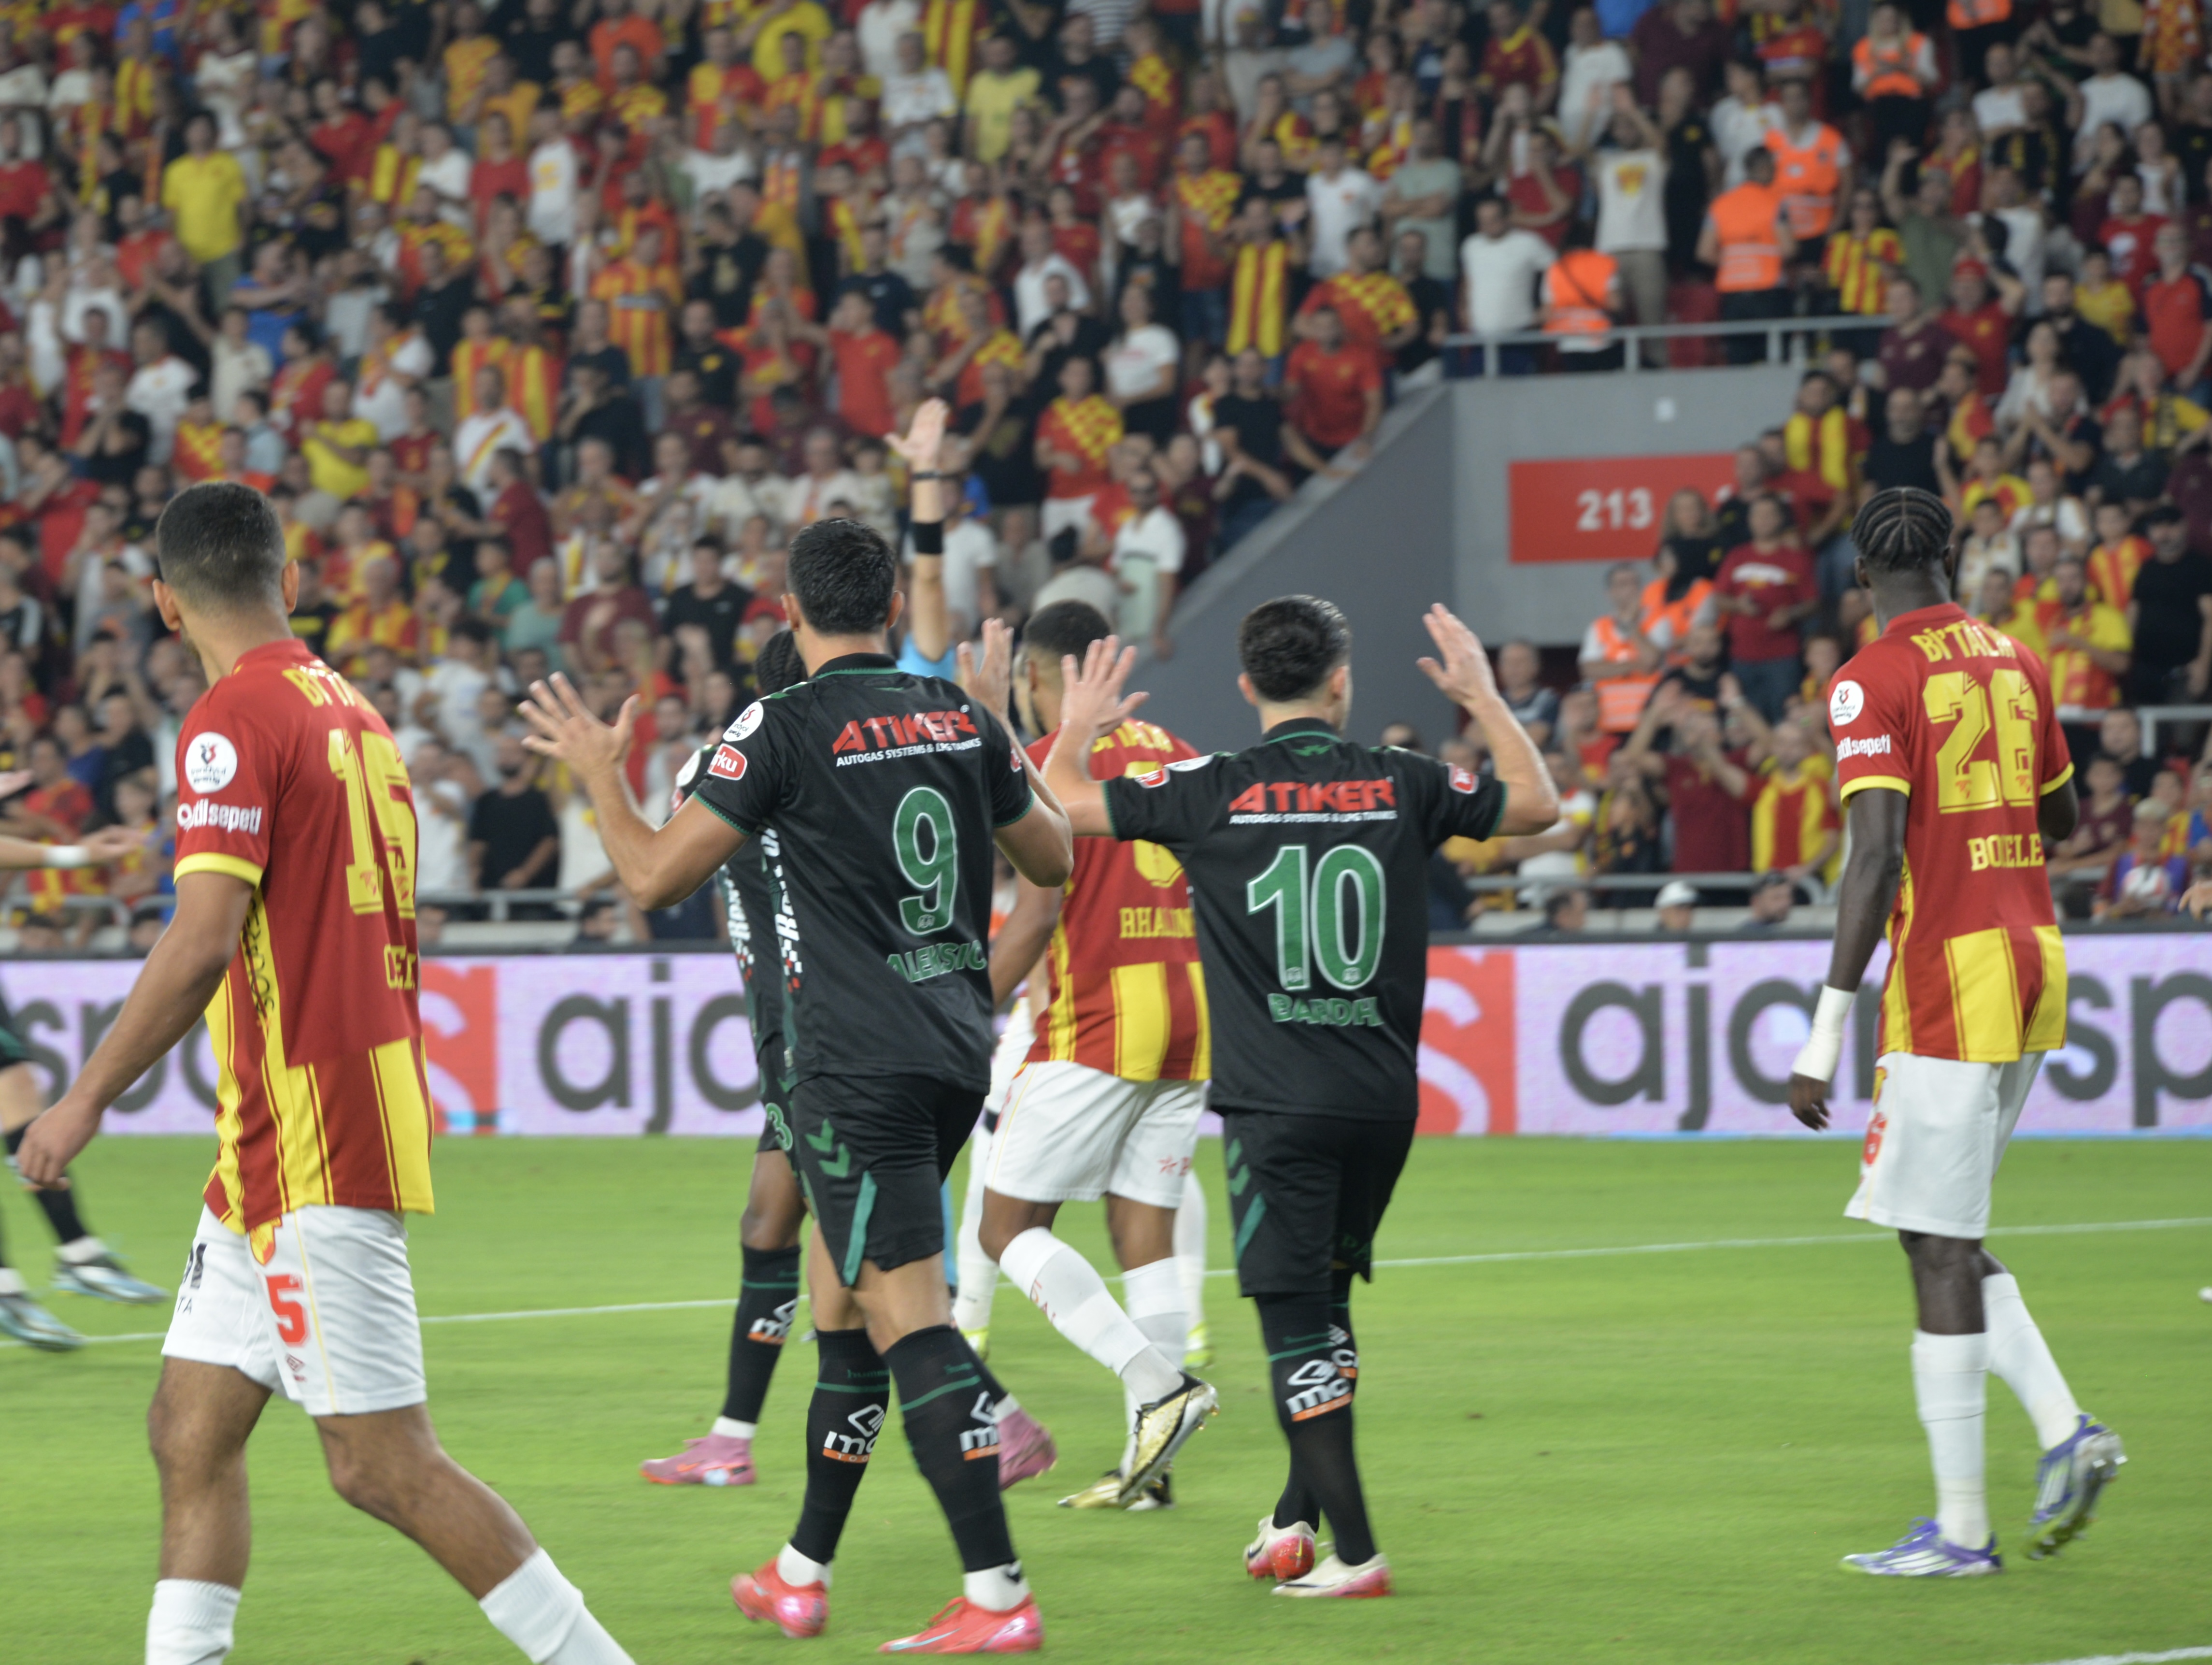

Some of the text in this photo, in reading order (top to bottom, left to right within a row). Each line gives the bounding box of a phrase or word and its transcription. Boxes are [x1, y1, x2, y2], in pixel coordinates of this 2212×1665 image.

[1577, 487, 1654, 531] 213
[832, 711, 978, 755] ATIKER
[836, 752, 885, 767] AUTOGAS
[885, 745, 926, 760] SYSTEMS
[1922, 668, 2039, 813] 26
[328, 728, 416, 919] 15
[1228, 779, 1396, 813] ATIKER
[893, 785, 958, 935] 9
[1246, 844, 1386, 990] 10
[267, 1274, 311, 1348] 5
